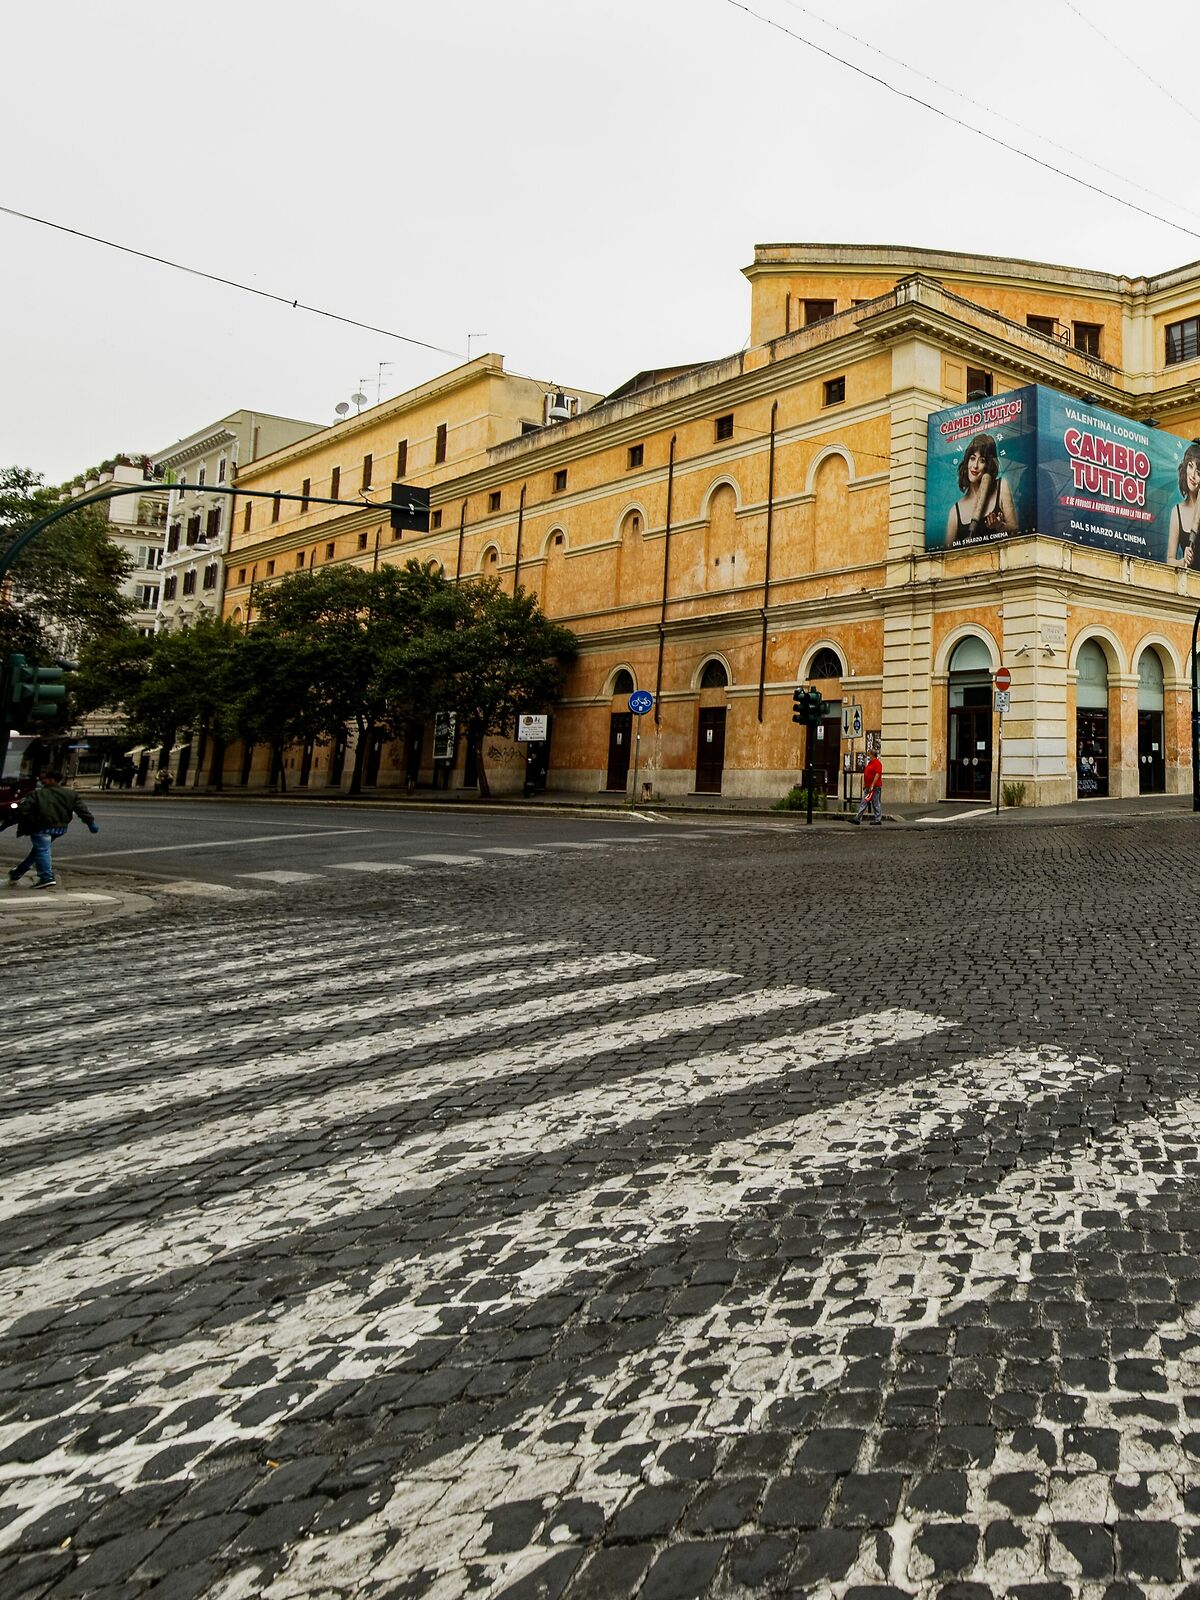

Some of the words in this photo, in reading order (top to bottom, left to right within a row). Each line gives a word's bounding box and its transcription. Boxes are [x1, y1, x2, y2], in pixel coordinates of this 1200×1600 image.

[940, 412, 982, 435] CAMBIO
[983, 399, 1022, 423] TUTTO!
[1065, 407, 1112, 433] VALENTINA
[1113, 425, 1149, 446] LODOVINI
[1064, 427, 1151, 479] CAMBIO
[1070, 458, 1146, 506] TUTTO!
[990, 531, 1009, 541] CINEMA
[1070, 520, 1084, 530] DAL
[1085, 524, 1090, 532] 5
[1090, 525, 1113, 537] MARZO
[1114, 531, 1122, 540] AL
[1123, 533, 1147, 546] CINEMA
